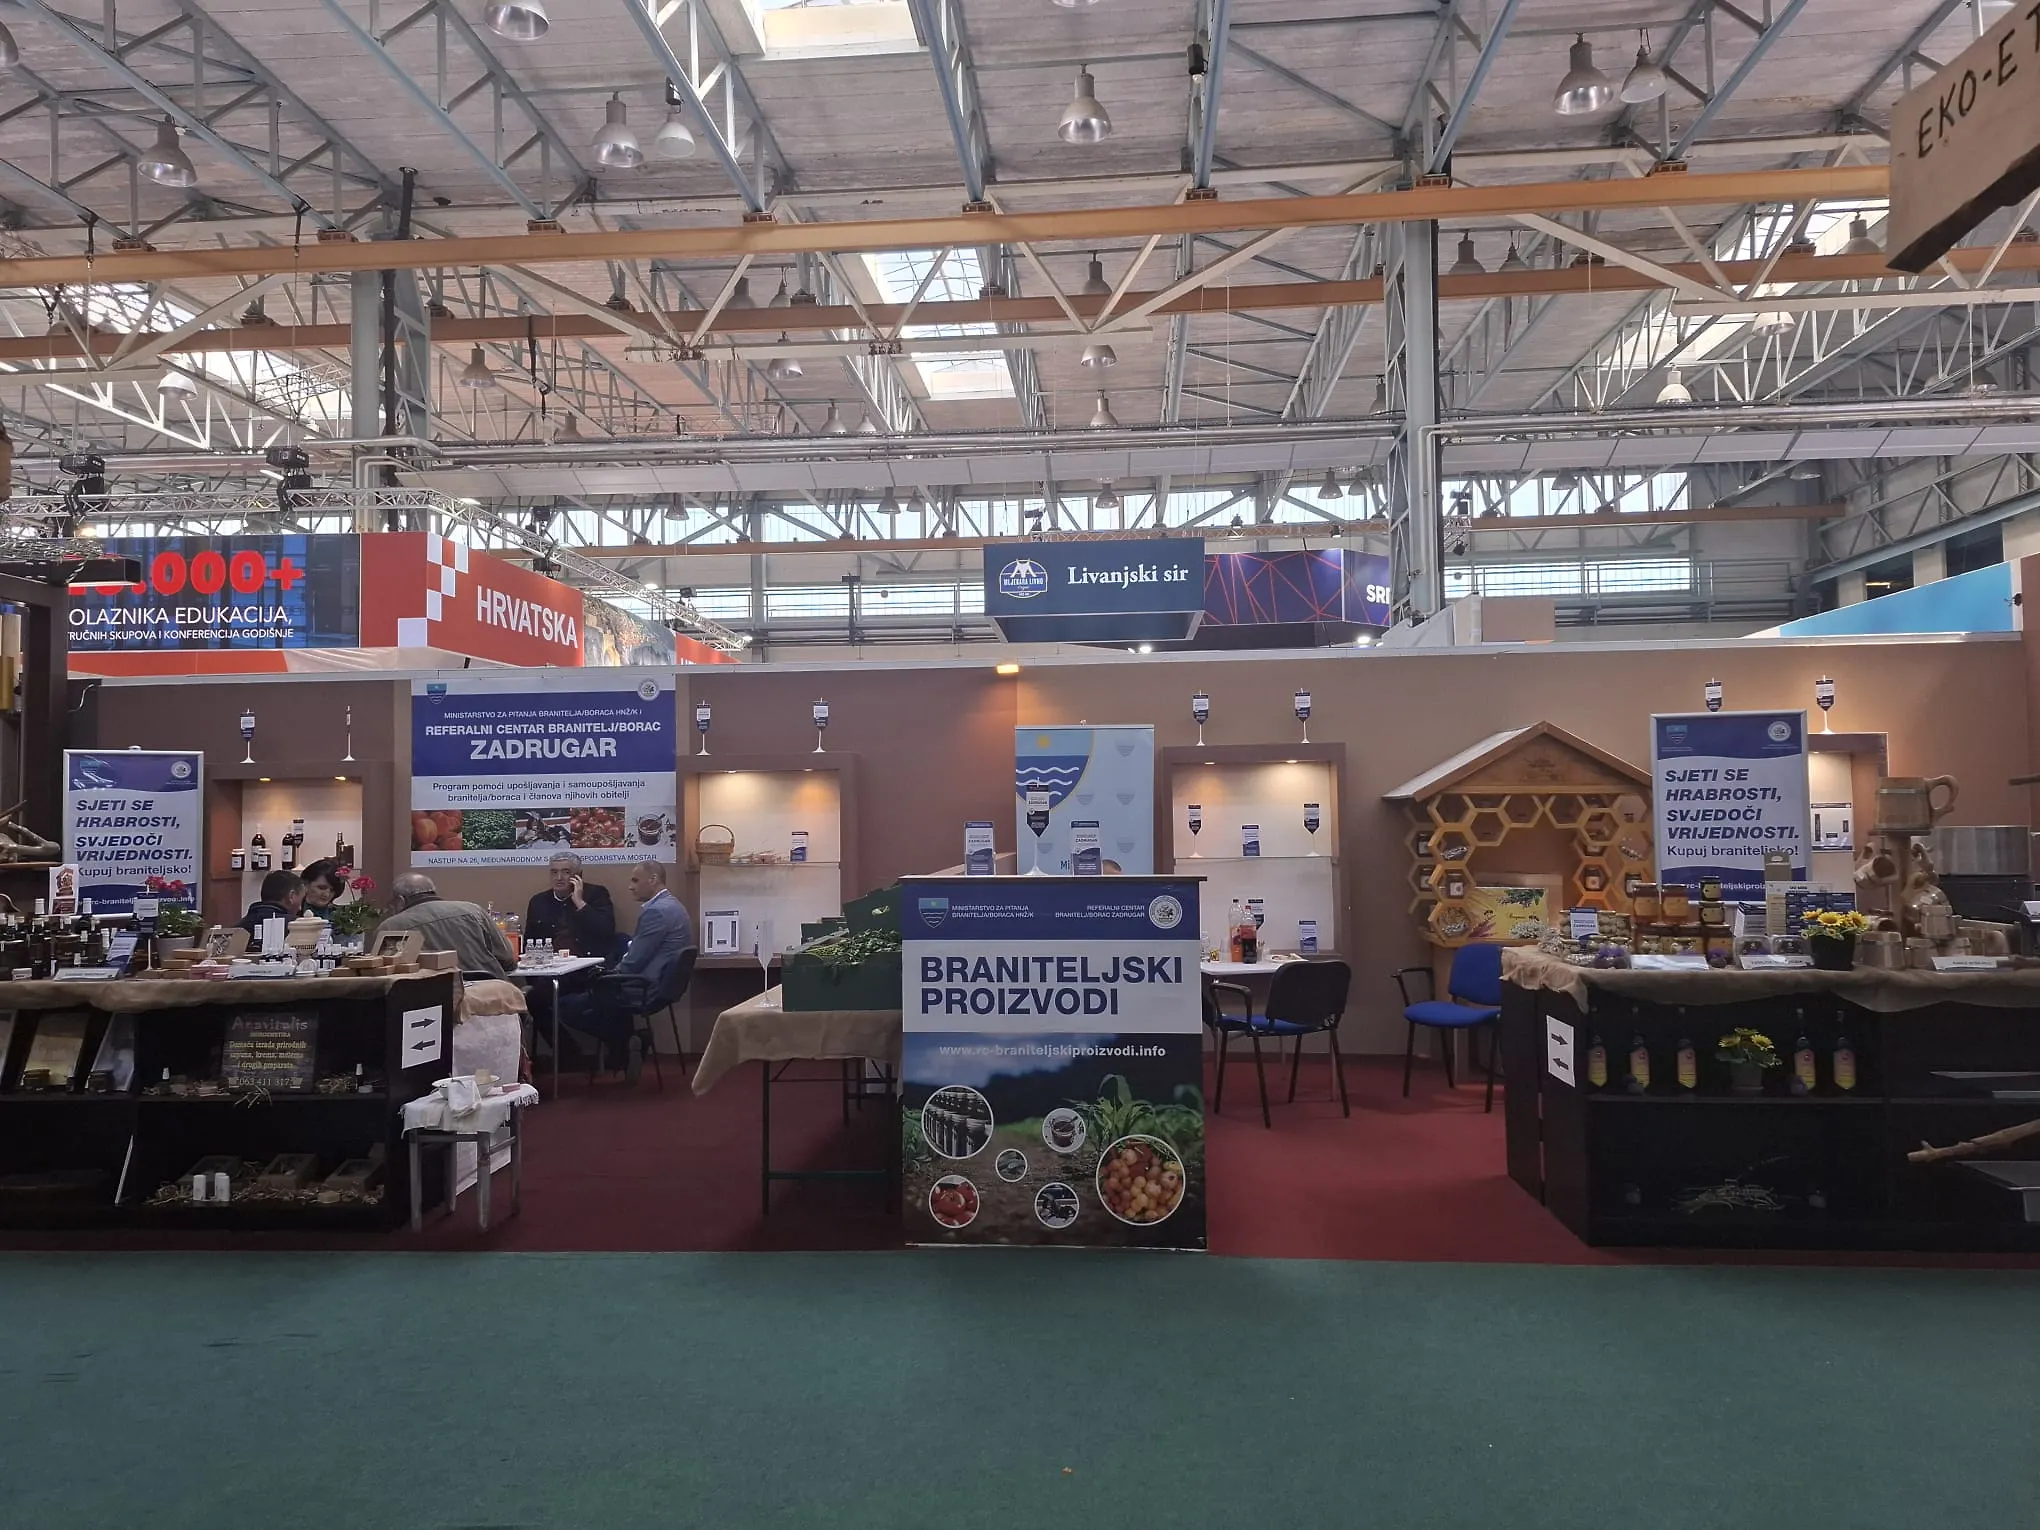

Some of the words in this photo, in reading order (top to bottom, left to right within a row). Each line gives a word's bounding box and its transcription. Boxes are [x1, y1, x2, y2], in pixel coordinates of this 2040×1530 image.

[66, 550, 304, 596] .000+
[1067, 564, 1158, 589] Livanjski
[1163, 564, 1189, 583] sir
[68, 607, 170, 626] OLAZNIKA
[175, 606, 293, 625] EDUKACIJA,
[477, 584, 579, 649] HRVATSKA
[109, 630, 157, 640] SKUPOVA
[163, 629, 239, 639] KONFERENCIJA
[242, 627, 294, 638] GODIŠNJE
[444, 711, 496, 719] MINISTARSTVO
[508, 710, 537, 718] PITANJA
[539, 709, 614, 718] BRANITELJA/BORACA
[425, 724, 493, 736] REFERALNI
[496, 723, 545, 734] CENTAR
[548, 721, 661, 733] BRANITELJ/BORAC
[470, 737, 617, 760] ZADRUGAR
[1665, 769, 1719, 782] SJETI
[1723, 768, 1749, 781] SE
[432, 782, 470, 793] Program
[472, 781, 504, 792] pomoći
[507, 780, 561, 791] upošljavanja
[567, 779, 645, 791] samoupošljavanja
[448, 792, 521, 803] branitelja/boraca
[528, 791, 562, 801] članova
[565, 791, 598, 802] njihovih
[600, 790, 630, 800] obitelji
[1665, 787, 1782, 802] HRABROSTI,
[75, 799, 126, 811] SJETI
[131, 799, 154, 811] SE
[1666, 805, 1762, 822] SVJEDOČI
[75, 816, 181, 829] HRABROSTI,
[75, 832, 164, 848] SVJEDOČI
[1667, 826, 1800, 841] VRIJEDNOSTI.
[75, 849, 193, 862] VRIJEDNOSTI.
[1667, 846, 1707, 858] Kupuj
[116, 864, 192, 877] braniteljsko!
[920, 956, 1183, 984] BRANITELJSKI
[920, 987, 1119, 1015] PROIZVODI
[939, 1044, 1167, 1059] www.rc-braniteljskiproizvodi.info
